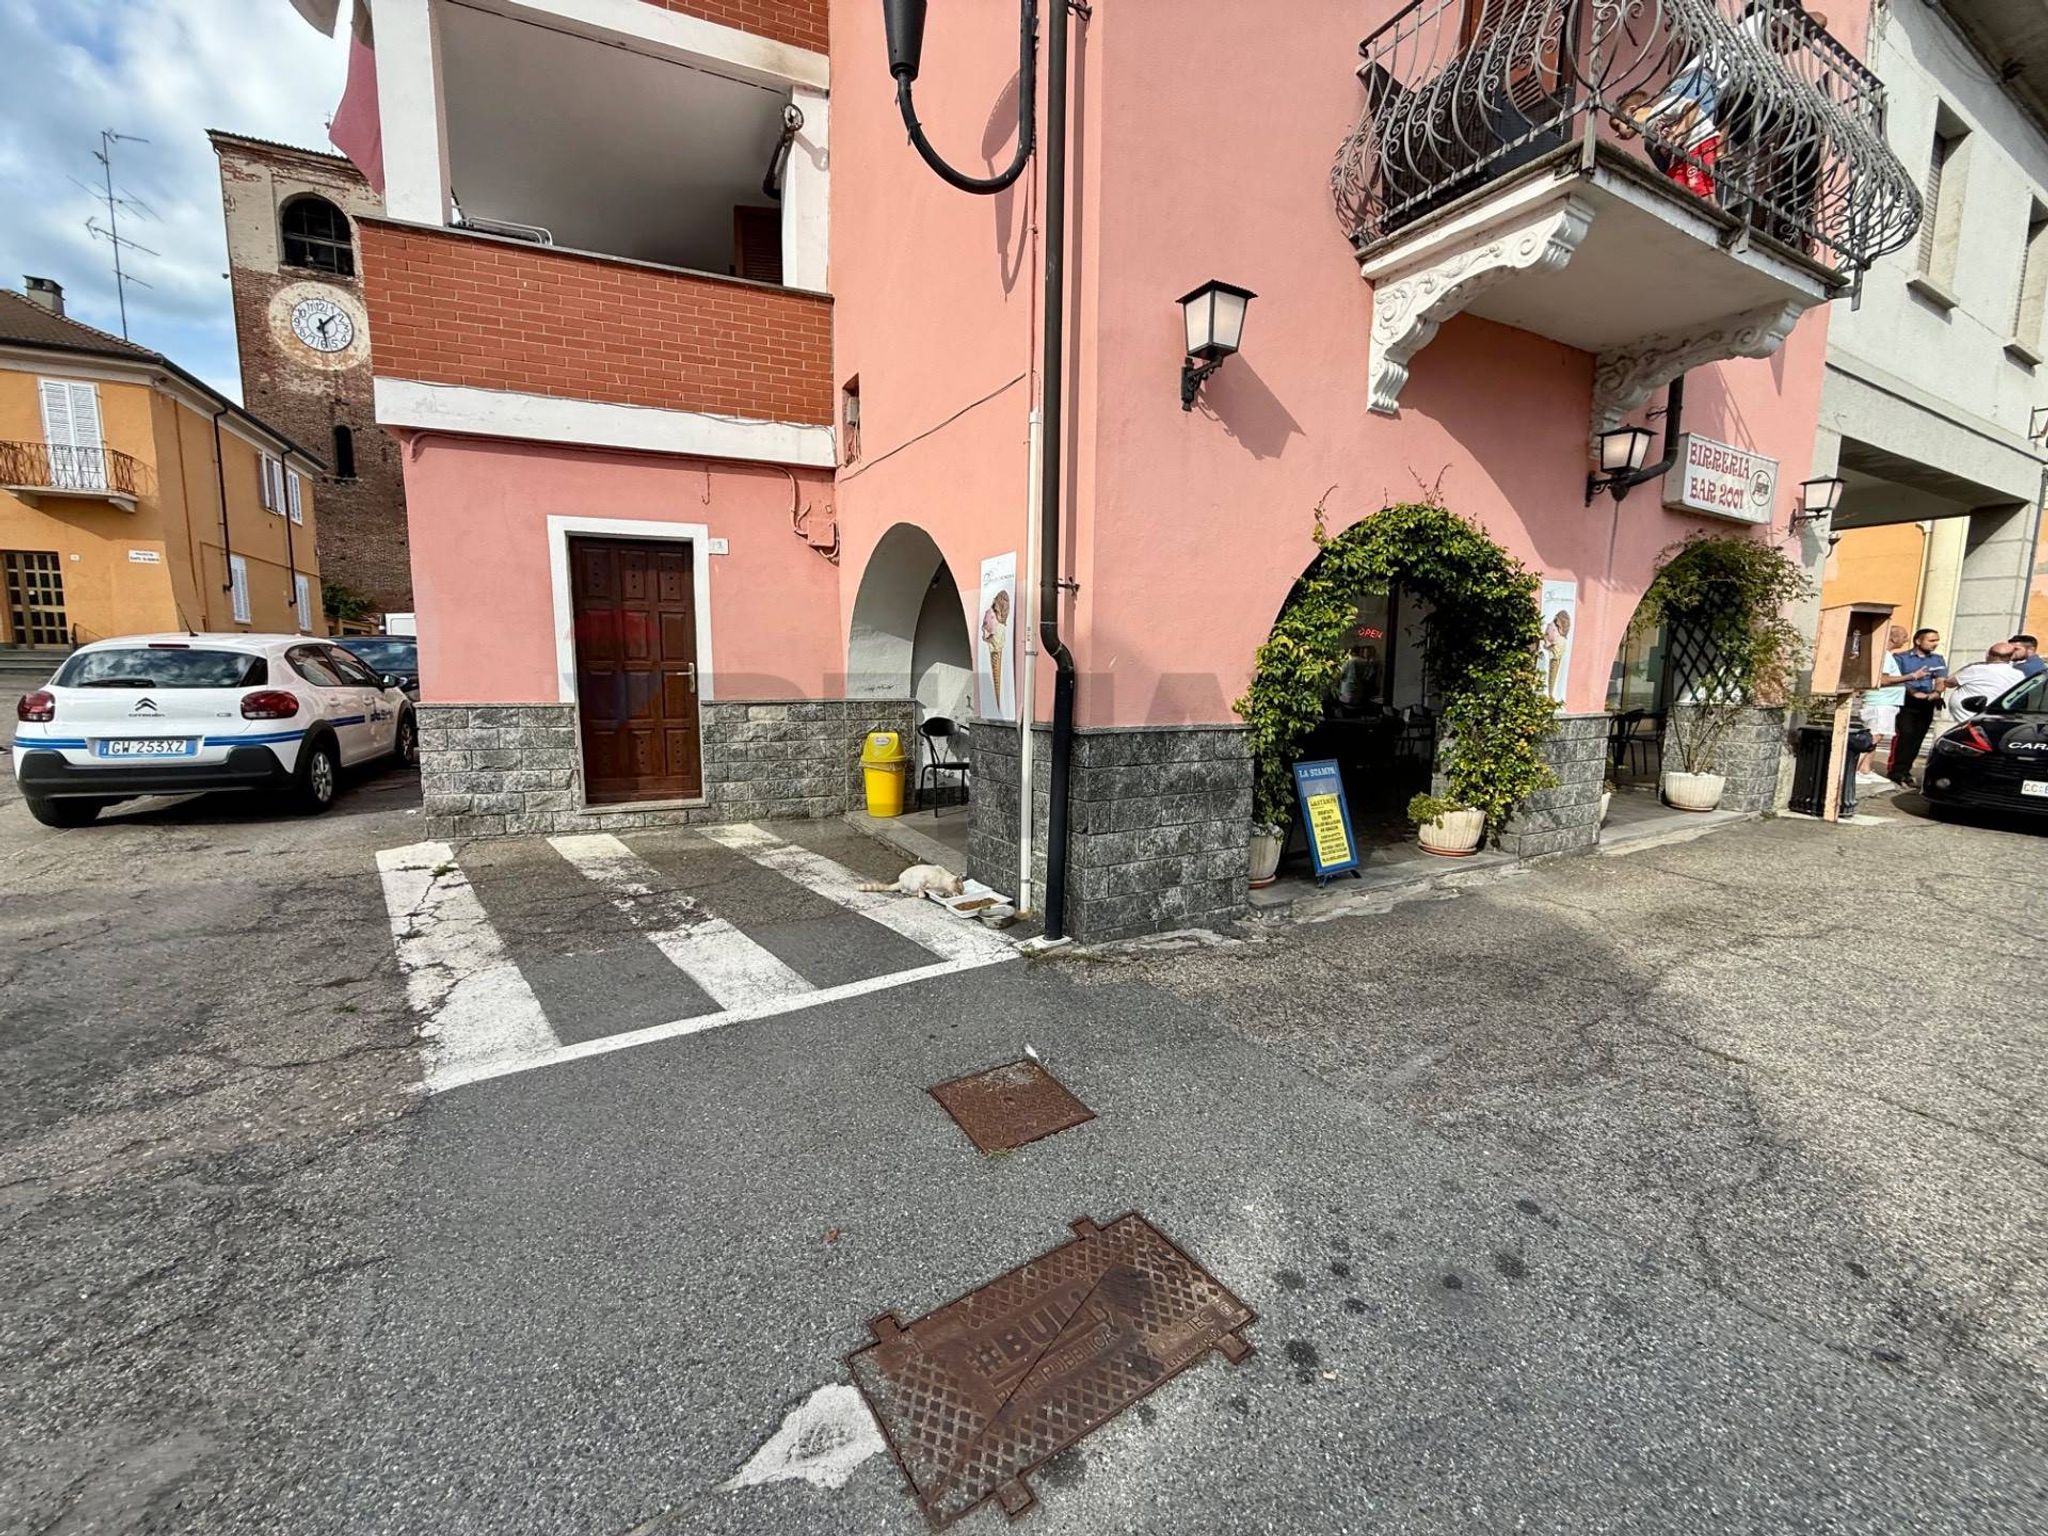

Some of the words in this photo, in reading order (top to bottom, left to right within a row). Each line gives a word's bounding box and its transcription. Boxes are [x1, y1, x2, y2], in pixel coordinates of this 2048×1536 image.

[316, 303, 325, 312] 12
[294, 317, 300, 327] 9
[338, 314, 344, 324] 2
[343, 324, 349, 333] 3
[340, 334, 346, 342] 4
[332, 340, 338, 348] 5
[1689, 442, 1750, 480] BIRRERIA
[1689, 476, 1717, 503] BAR
[1358, 627, 1384, 640] OPEN
[111, 741, 130, 753] GW
[136, 740, 184, 753] 253XZ
[2008, 742, 2048, 750] CAR
[1298, 769, 1309, 778] LA
[1309, 766, 1336, 777] STAMPA
[1040, 1328, 1119, 1381] PUBBLICA
